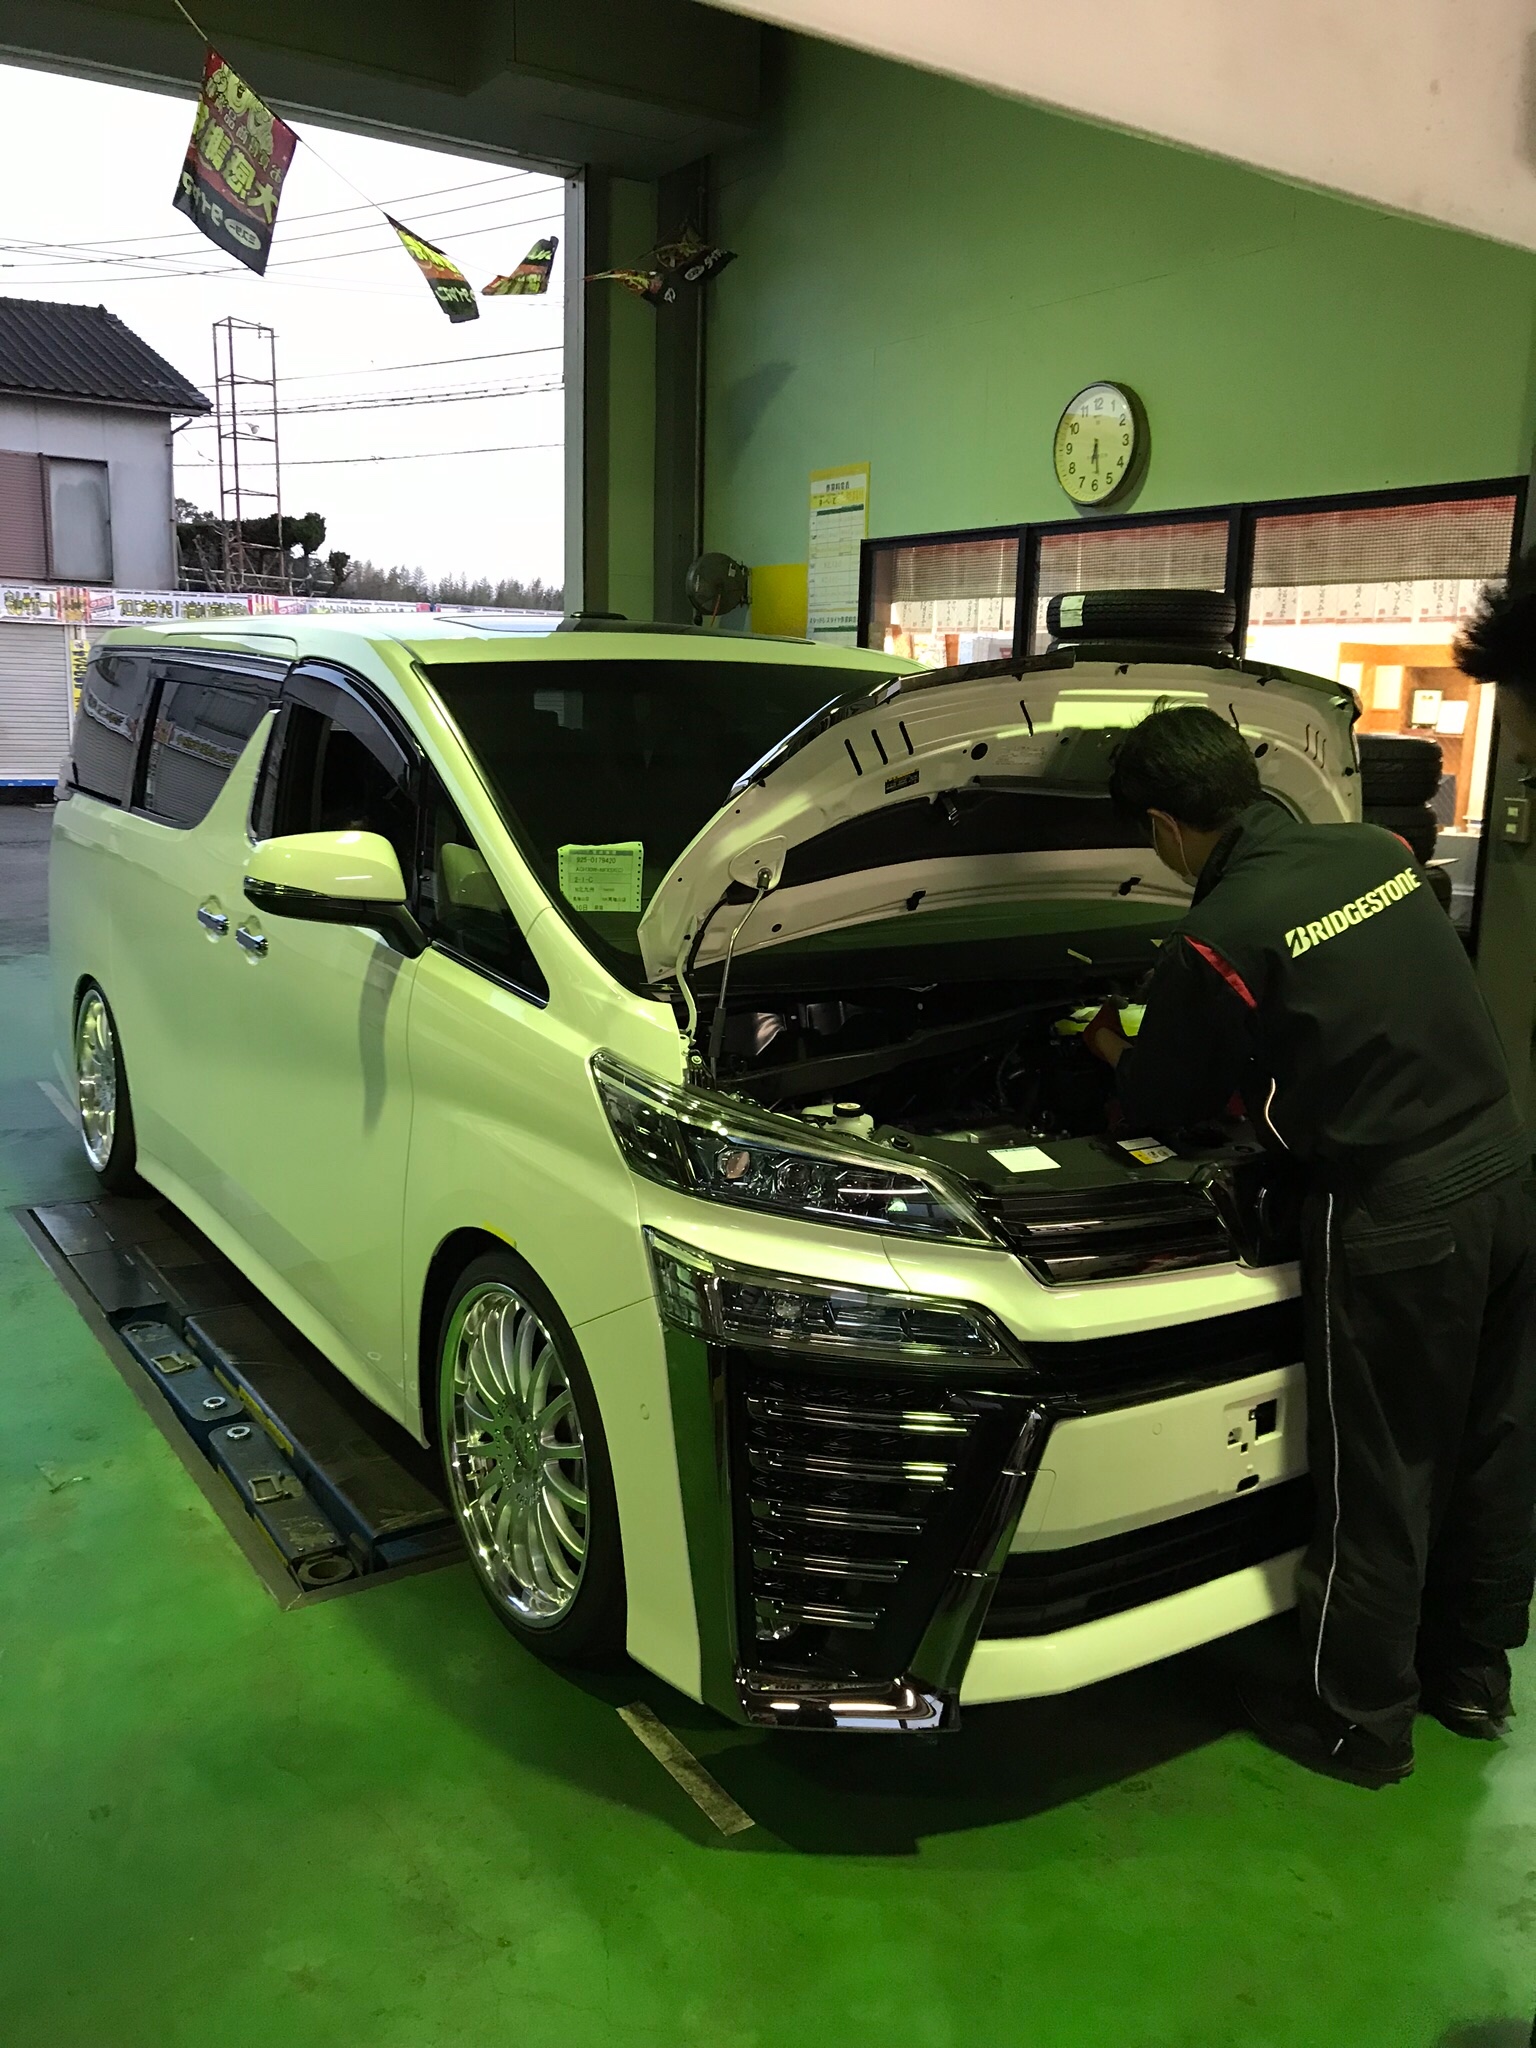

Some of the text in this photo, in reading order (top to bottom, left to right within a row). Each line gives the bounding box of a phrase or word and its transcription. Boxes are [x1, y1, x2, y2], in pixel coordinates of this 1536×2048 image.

[1093, 397, 1104, 411] 12
[1111, 399, 1115, 412] 1
[1081, 405, 1089, 418] 11
[1119, 413, 1126, 427] 2
[1069, 422, 1080, 435] 10
[1122, 433, 1129, 446] 3
[1065, 443, 1072, 455] 9
[1069, 462, 1075, 474] 8
[1117, 456, 1124, 467] 4
[1079, 476, 1085, 488] 7
[1091, 479, 1098, 491] 6
[1106, 472, 1113, 485] 5
[1285, 867, 1421, 958] BRIDGESTONE
